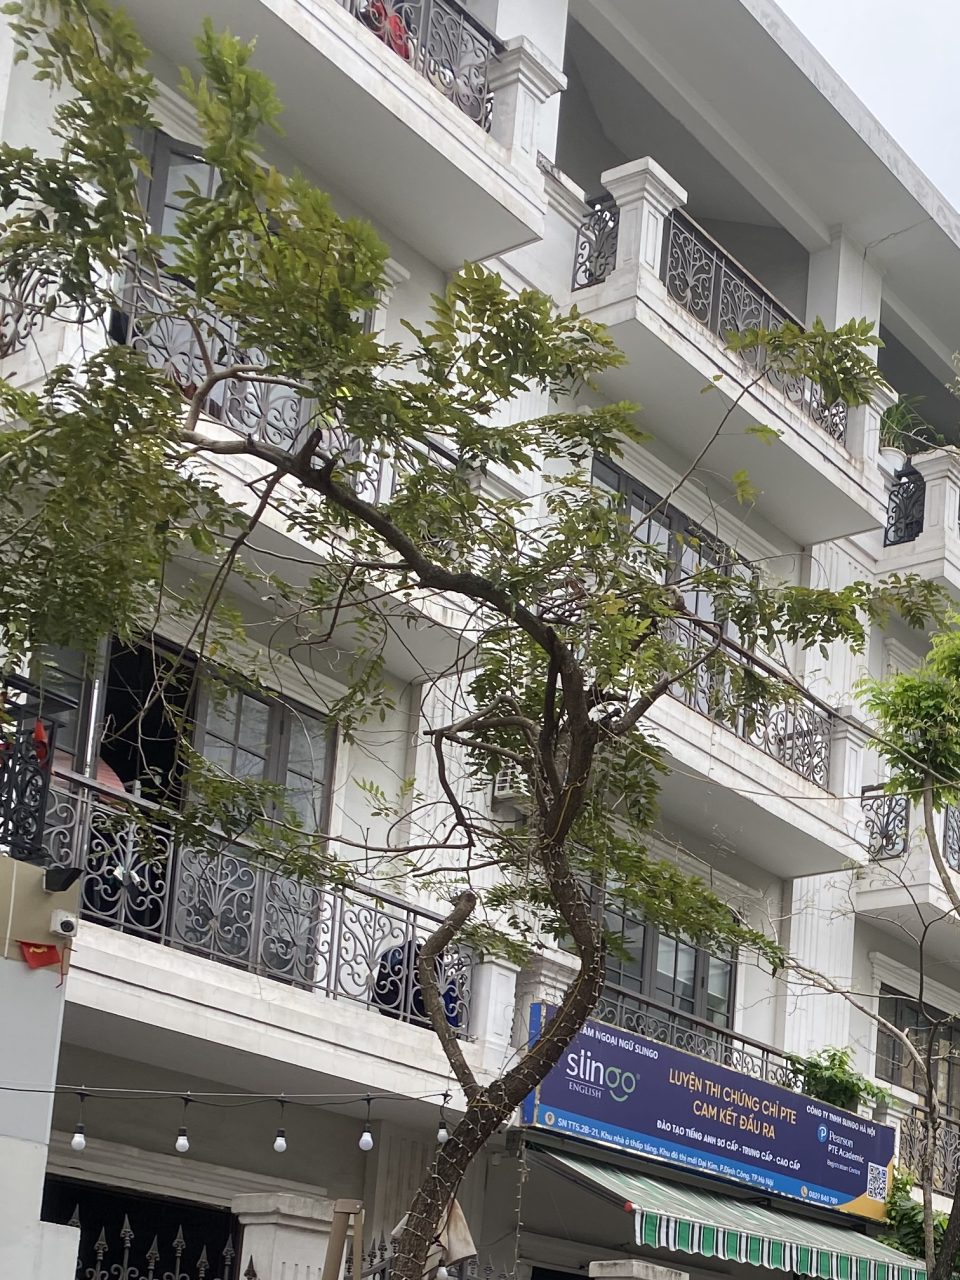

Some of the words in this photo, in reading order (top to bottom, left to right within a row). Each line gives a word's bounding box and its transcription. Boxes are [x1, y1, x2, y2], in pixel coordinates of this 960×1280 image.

[580, 1023, 594, 1037] ÂM
[596, 1031, 618, 1046] NGOẠI
[619, 1039, 635, 1051] NGỮ
[634, 1044, 659, 1060] SLINGO
[566, 1049, 636, 1102] slingo
[569, 1081, 602, 1099] ENGLISH
[669, 1068, 703, 1094] LUYỆN
[705, 1080, 720, 1099] THI
[723, 1087, 760, 1112] CHỨNG
[762, 1100, 779, 1119] CHỈ
[780, 1106, 797, 1124] PTE
[693, 1100, 717, 1121] CAM
[719, 1106, 738, 1127] KẾT
[762, 1121, 776, 1140] RA
[806, 1104, 822, 1117] CÔNG
[822, 1110, 829, 1119] TY
[829, 1112, 842, 1125] TNHH
[842, 1118, 859, 1131] SLINGO
[558, 1118, 568, 1128] SN
[600, 1129, 613, 1141] Khu
[659, 1146, 671, 1157] Khu
[656, 1119, 671, 1132] ĐÀO
[672, 1124, 684, 1136] TẠO
[685, 1127, 702, 1141] TIẾNG
[703, 1134, 716, 1145] ANH
[726, 1140, 739, 1152] CẤP
[742, 1145, 760, 1159] TRUNG
[761, 1150, 773, 1162] CẤP
[776, 1156, 789, 1168] CAO
[789, 1159, 801, 1171] CẤP
[828, 1144, 838, 1155] PTE
[839, 1148, 865, 1163] Academic
[829, 1130, 854, 1148] Pearson
